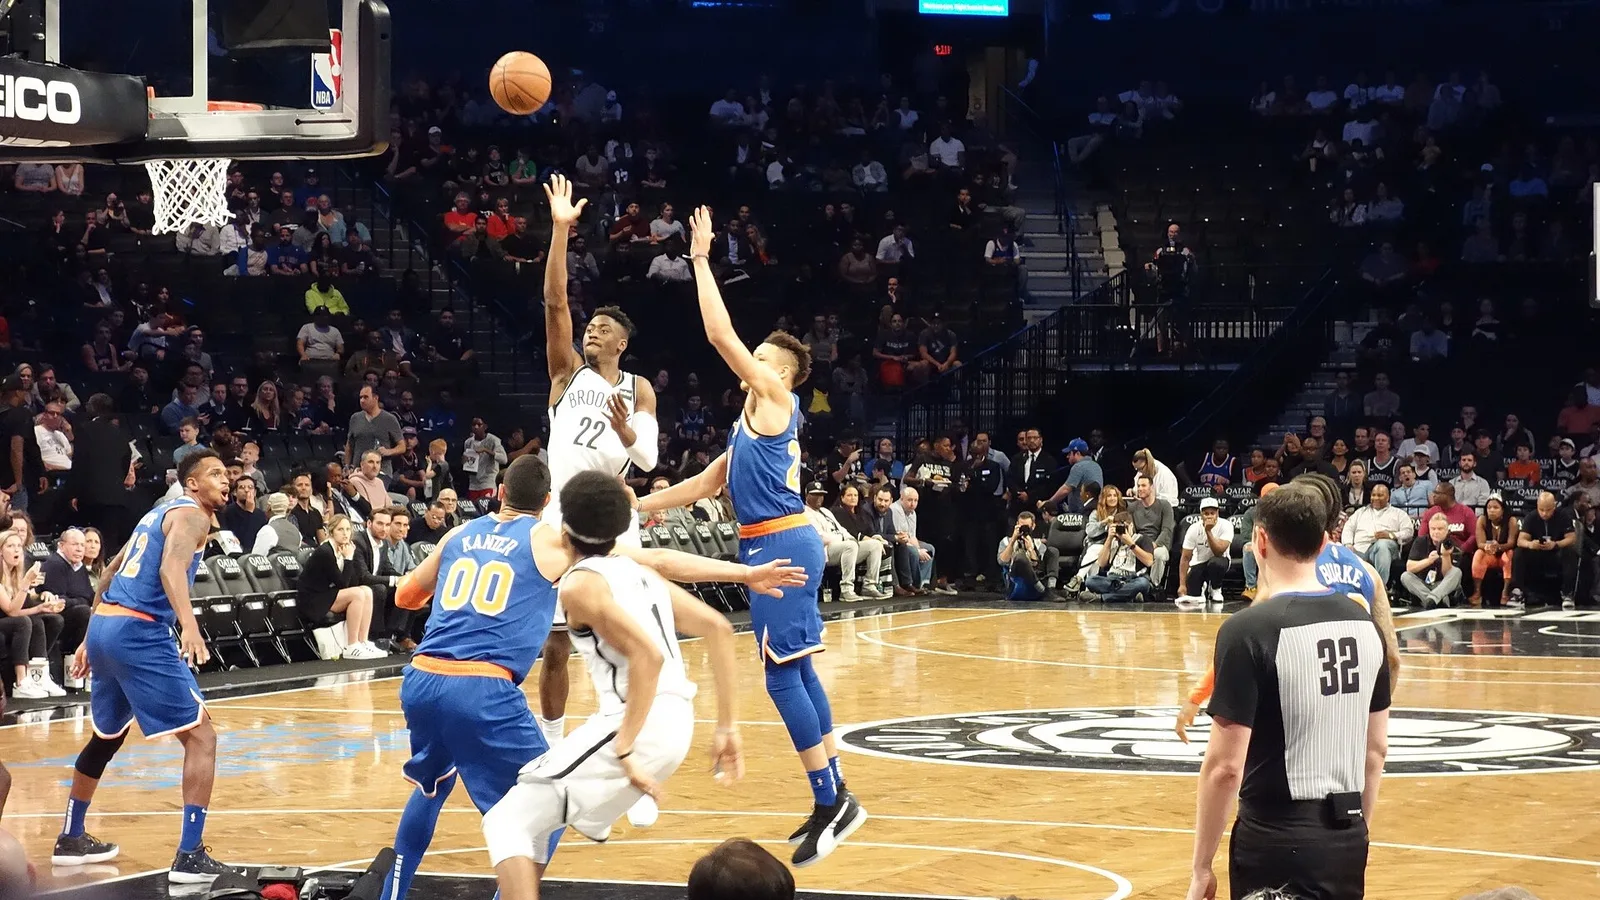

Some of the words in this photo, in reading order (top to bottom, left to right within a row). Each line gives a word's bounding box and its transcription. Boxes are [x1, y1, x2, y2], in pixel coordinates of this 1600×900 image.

[0, 73, 81, 125] ICO
[315, 90, 331, 105] NBA
[573, 416, 606, 450] 22
[1498, 479, 1525, 488] QATAR
[1540, 479, 1567, 488] QATAR
[1185, 487, 1212, 495] QATAR
[1225, 487, 1252, 496] QATAR
[1057, 514, 1084, 524] QATAR
[461, 533, 519, 557] KANTER
[216, 558, 240, 570] QATAR
[248, 555, 272, 567] QATAR
[277, 555, 299, 567] QATAR
[1318, 562, 1364, 589] BURKE
[439, 557, 516, 617] 00
[1316, 636, 1360, 697] 32
